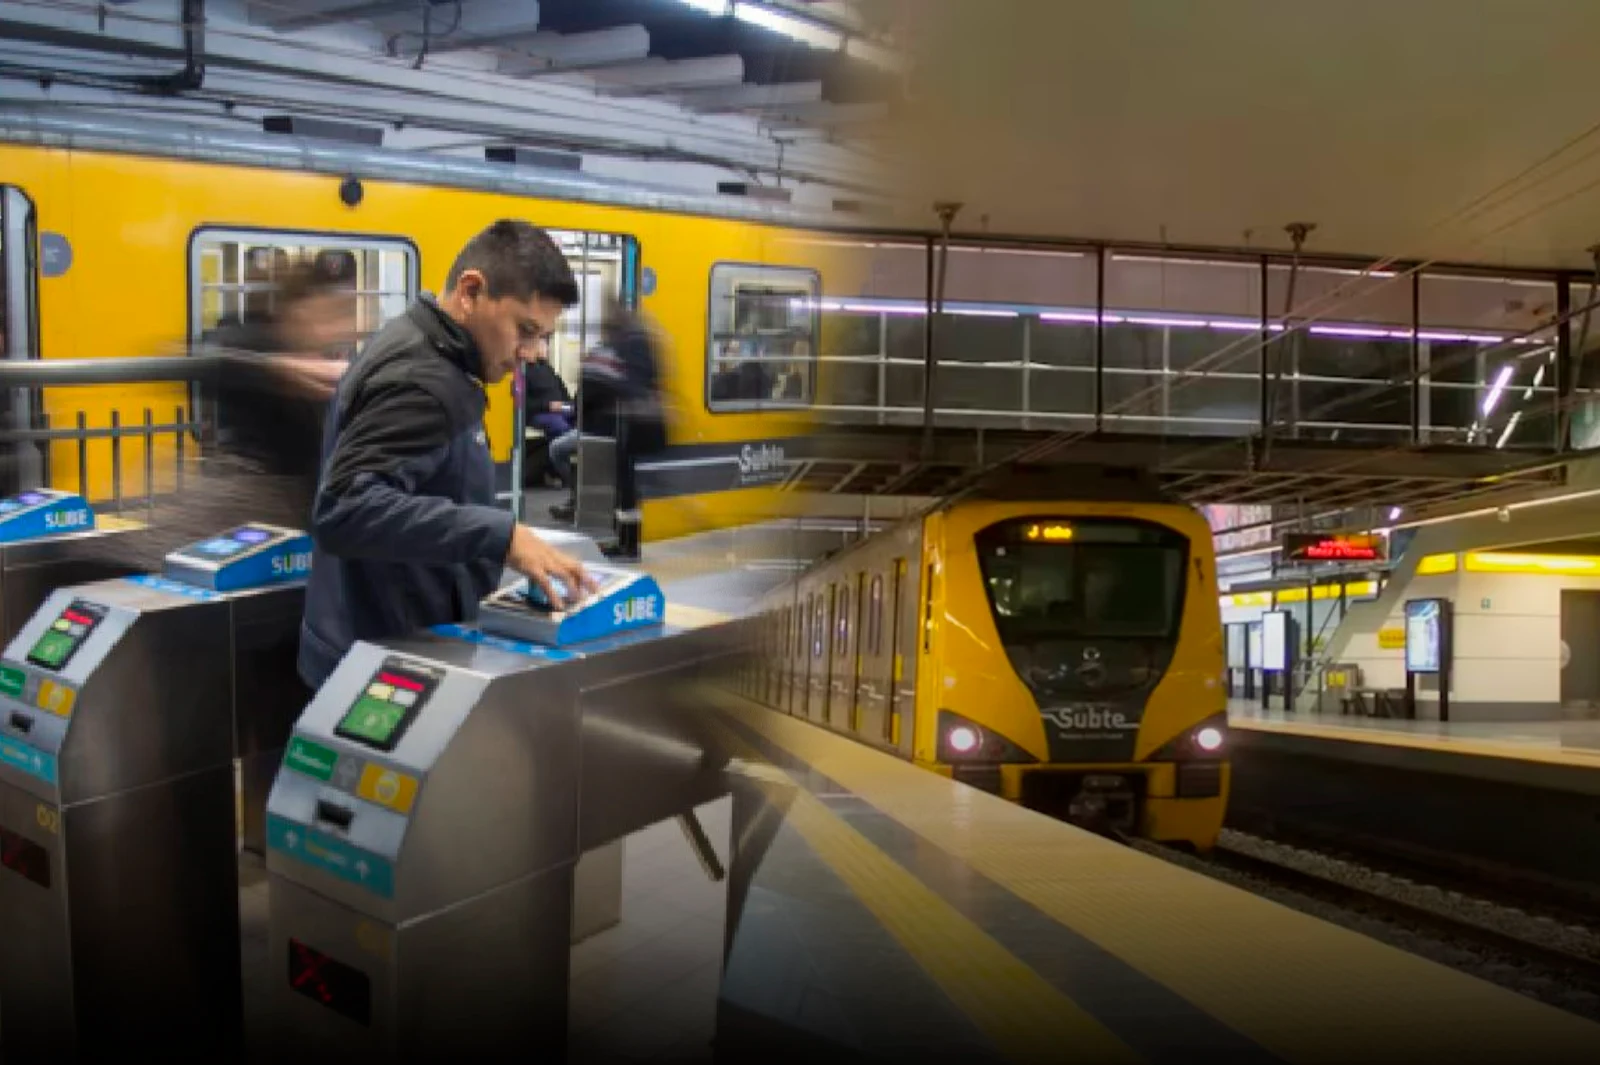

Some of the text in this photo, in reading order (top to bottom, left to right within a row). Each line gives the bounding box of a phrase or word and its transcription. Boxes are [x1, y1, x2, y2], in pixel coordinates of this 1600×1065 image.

[45, 509, 88, 528] SUBE
[613, 594, 657, 625] SUBE
[1058, 707, 1127, 729] Subte
